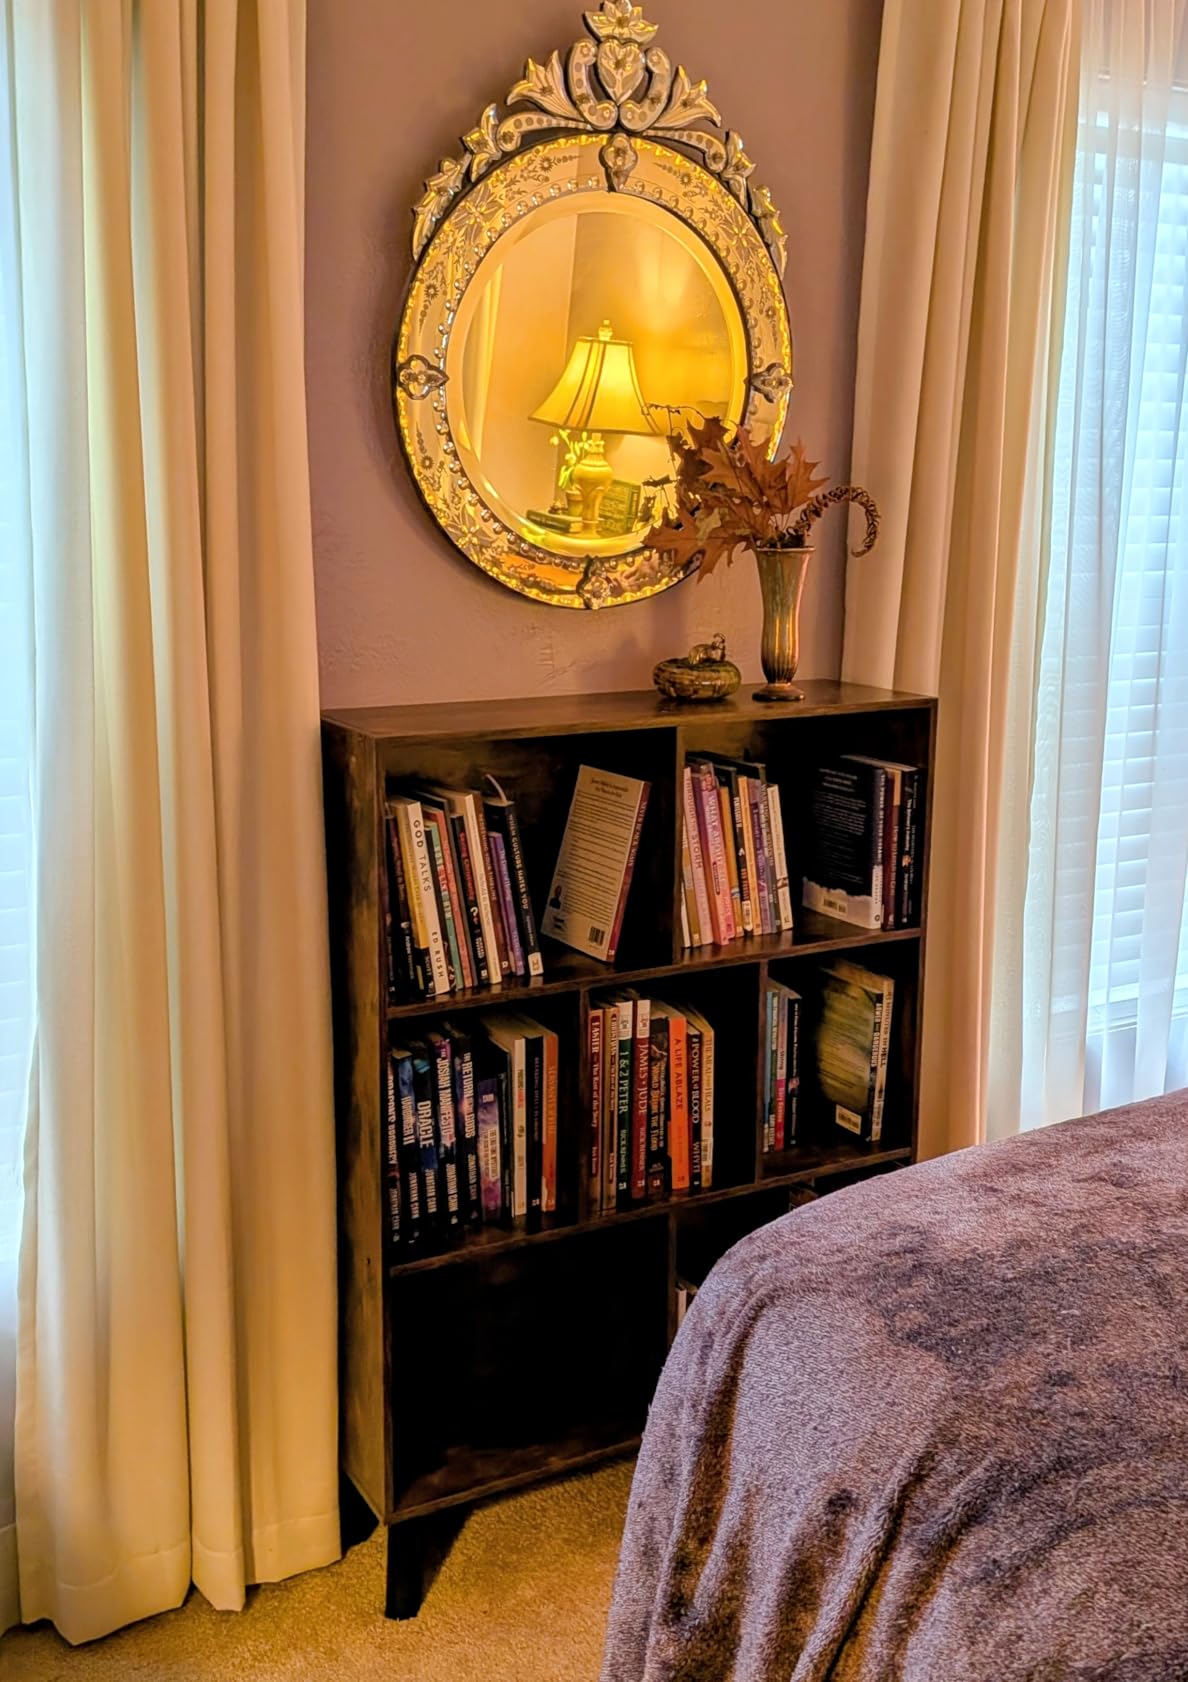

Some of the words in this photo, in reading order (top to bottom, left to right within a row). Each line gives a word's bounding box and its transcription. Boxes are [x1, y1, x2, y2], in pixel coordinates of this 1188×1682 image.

[685, 777, 696, 819] THROUGH
[692, 834, 702, 869] STORM
[707, 796, 720, 830] WHAT
[413, 819, 424, 848] GOD
[419, 855, 432, 892] TALKS
[512, 837, 522, 868] CULTURE
[712, 830, 725, 865] ABOUT
[462, 859, 476, 901] Christianity
[488, 872, 497, 901] TIMELINE
[517, 869, 526, 892] HATES
[521, 893, 529, 909] YOU
[404, 935, 412, 955] Andrew
[432, 931, 439, 944] ED
[434, 950, 444, 978] RUSH
[592, 1022, 600, 1053] EASTER
[871, 1031, 880, 1067] DANGEROUS
[883, 1037, 888, 1046] IN
[619, 1059, 629, 1069] &
[638, 1044, 648, 1079] JAMES
[880, 1047, 888, 1068] HELL
[436, 1057, 451, 1088] JOSIAH
[462, 1062, 474, 1097] RETURN
[652, 1063, 660, 1088] WORLD
[618, 1080, 629, 1114] PETER
[638, 1087, 648, 1115] JUDE
[675, 1072, 683, 1110] ABLAZE
[416, 1100, 435, 1148] ORACLE
[439, 1089, 454, 1136] MANIFESTO
[464, 1114, 476, 1138] GODS
[620, 1129, 628, 1147] RICK
[650, 1129, 659, 1151] FLOOD
[425, 1169, 437, 1196] JONATHAN
[446, 1163, 457, 1194] JONATHAN
[468, 1154, 477, 1183] JONATHAN
[409, 1172, 419, 1202] JONATHAN
[390, 1189, 398, 1214] JONATHAN
[410, 1203, 420, 1219] CAHN
[427, 1197, 438, 1213] CAHN
[448, 1194, 459, 1212] CAHN
[392, 1216, 400, 1230] CAHN
